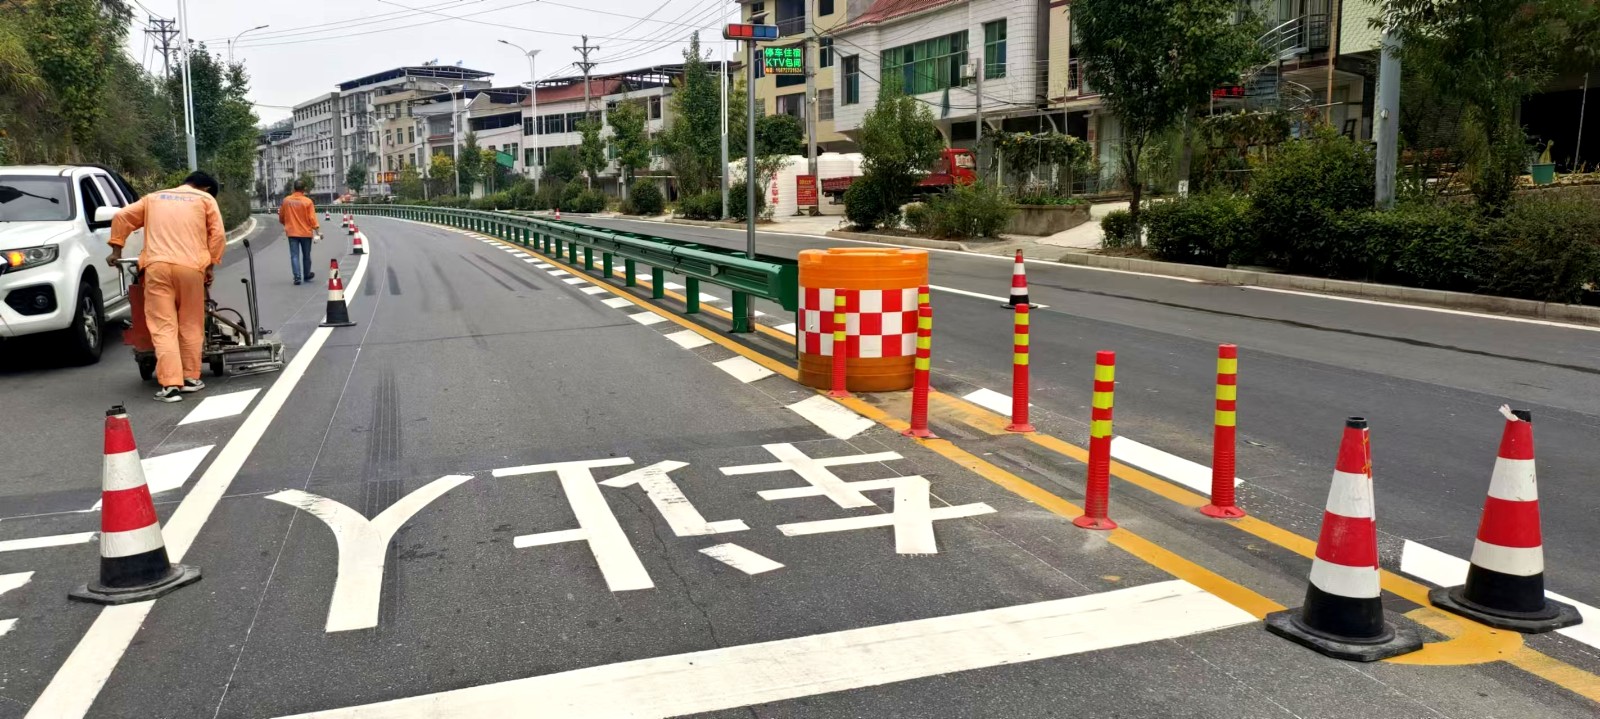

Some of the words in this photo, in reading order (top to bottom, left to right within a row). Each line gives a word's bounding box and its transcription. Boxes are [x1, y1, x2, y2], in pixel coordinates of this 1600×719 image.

[765, 48, 801, 57] 停车住宿
[765, 58, 801, 67] KTV包间
